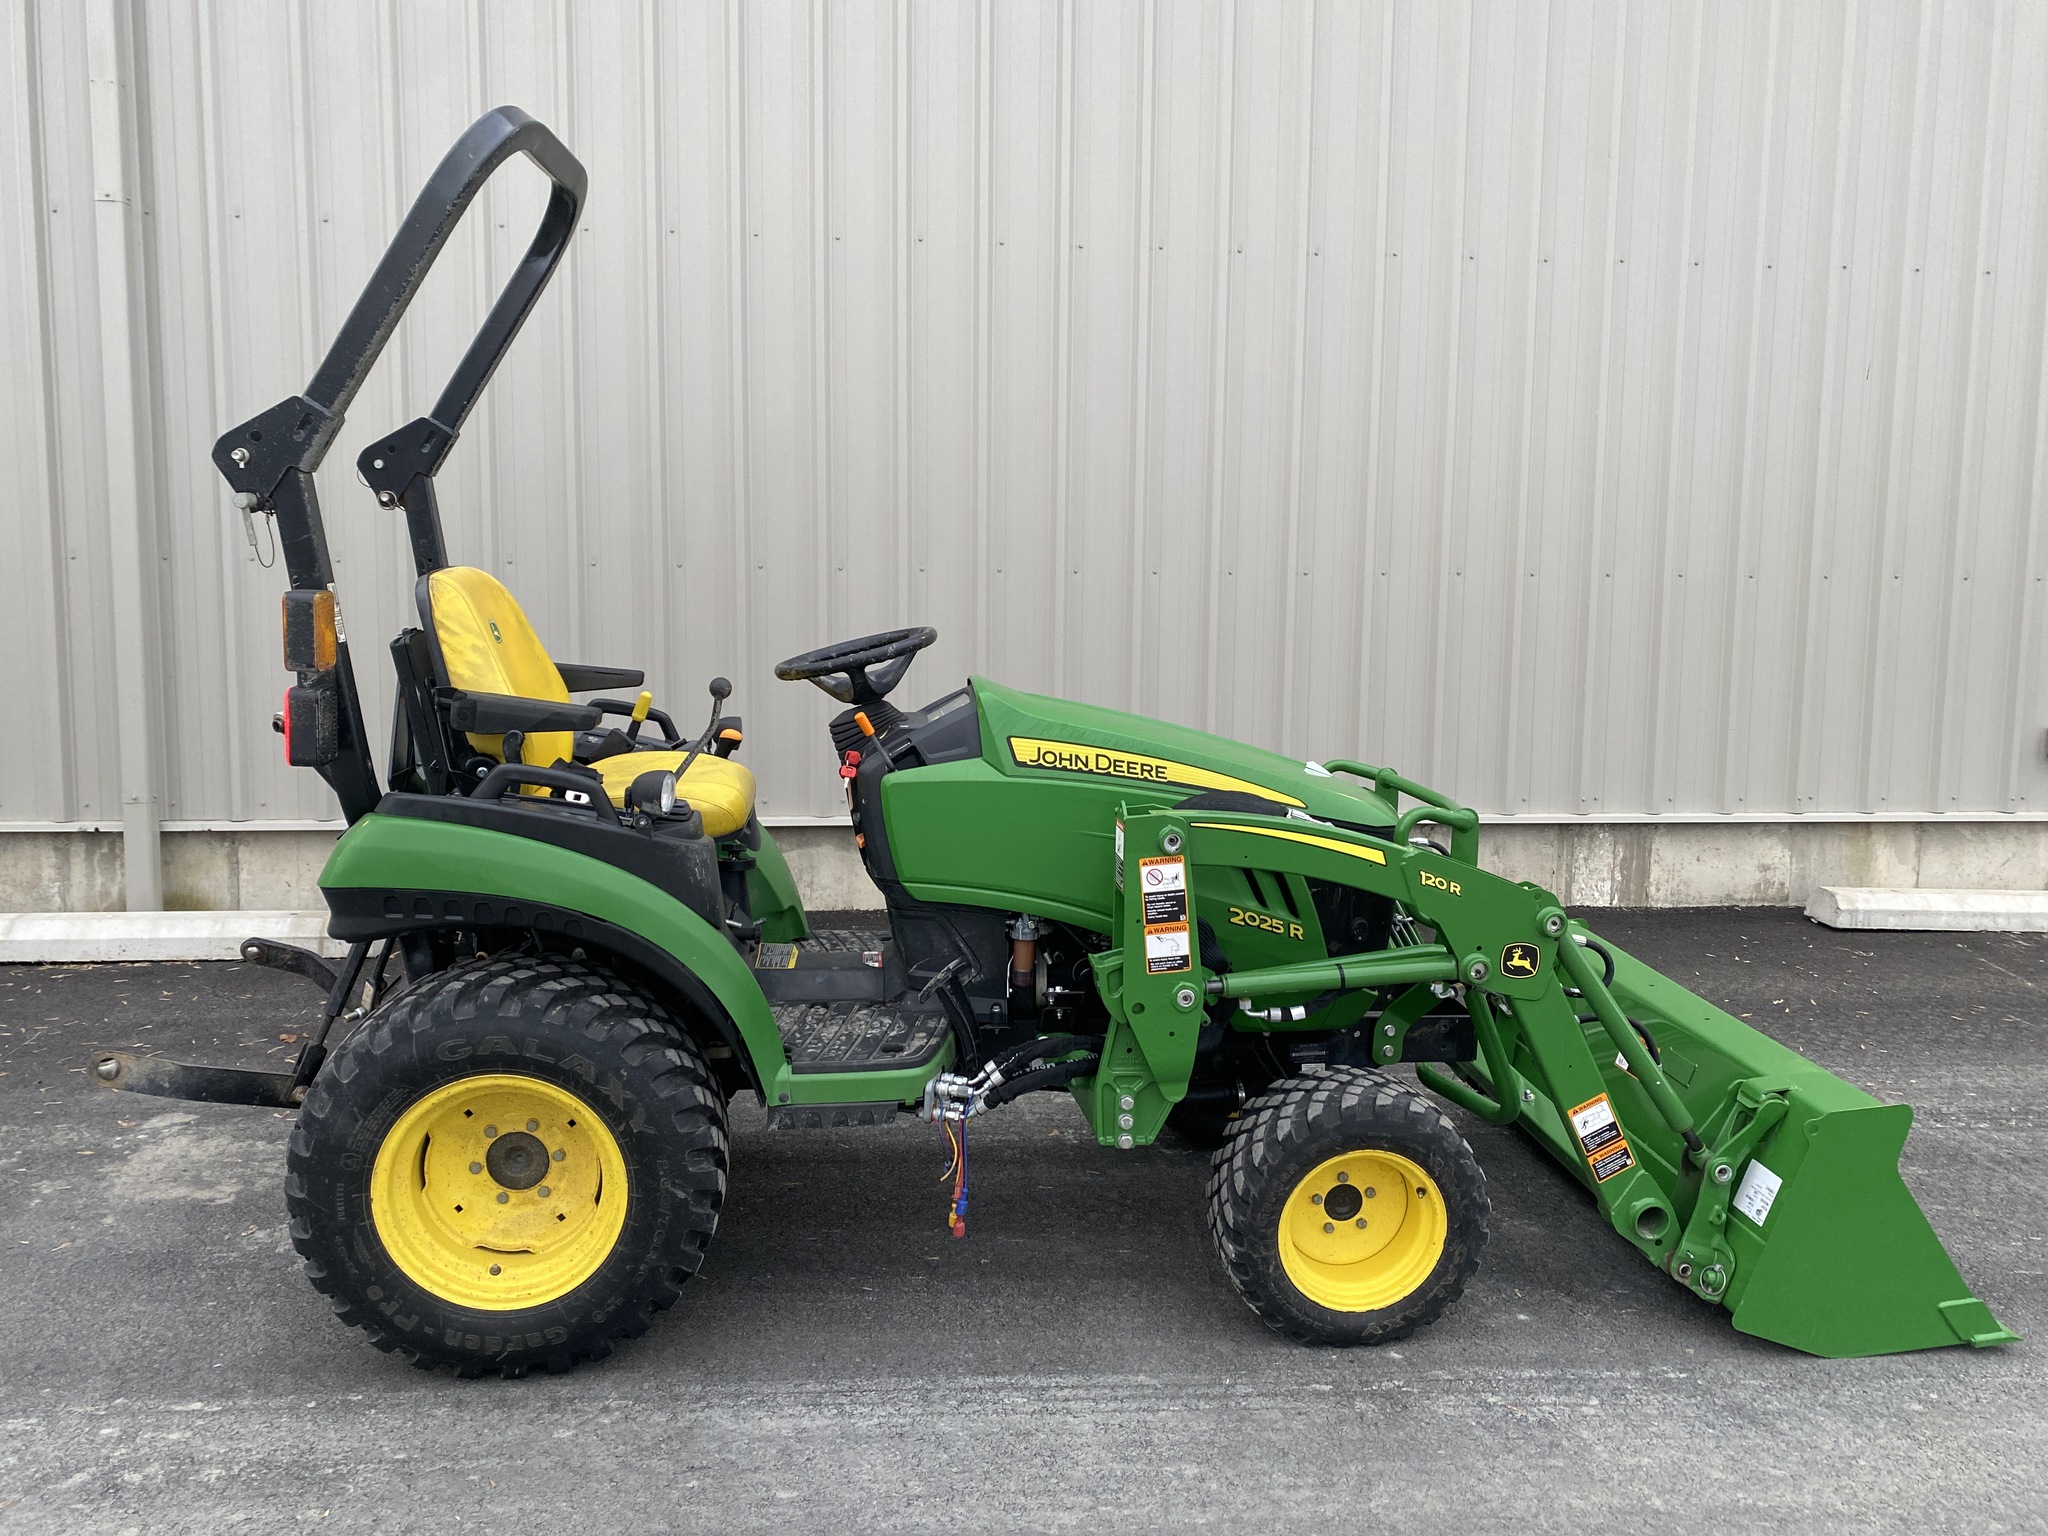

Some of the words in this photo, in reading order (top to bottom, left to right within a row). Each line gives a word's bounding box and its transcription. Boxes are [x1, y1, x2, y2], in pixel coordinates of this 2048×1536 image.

[1029, 747, 1089, 769] JOHN
[1095, 755, 1168, 780] DEERE
[1148, 856, 1182, 865] WARNING
[1419, 869, 1448, 890] 120
[1449, 881, 1462, 896] R
[1153, 925, 1187, 934] WARNING
[1229, 907, 1285, 935] 2025
[1289, 922, 1304, 941] R
[436, 1036, 658, 1136] GALAXY
[1578, 1097, 1603, 1112] WARNING
[1599, 1143, 1623, 1159] WARNING
